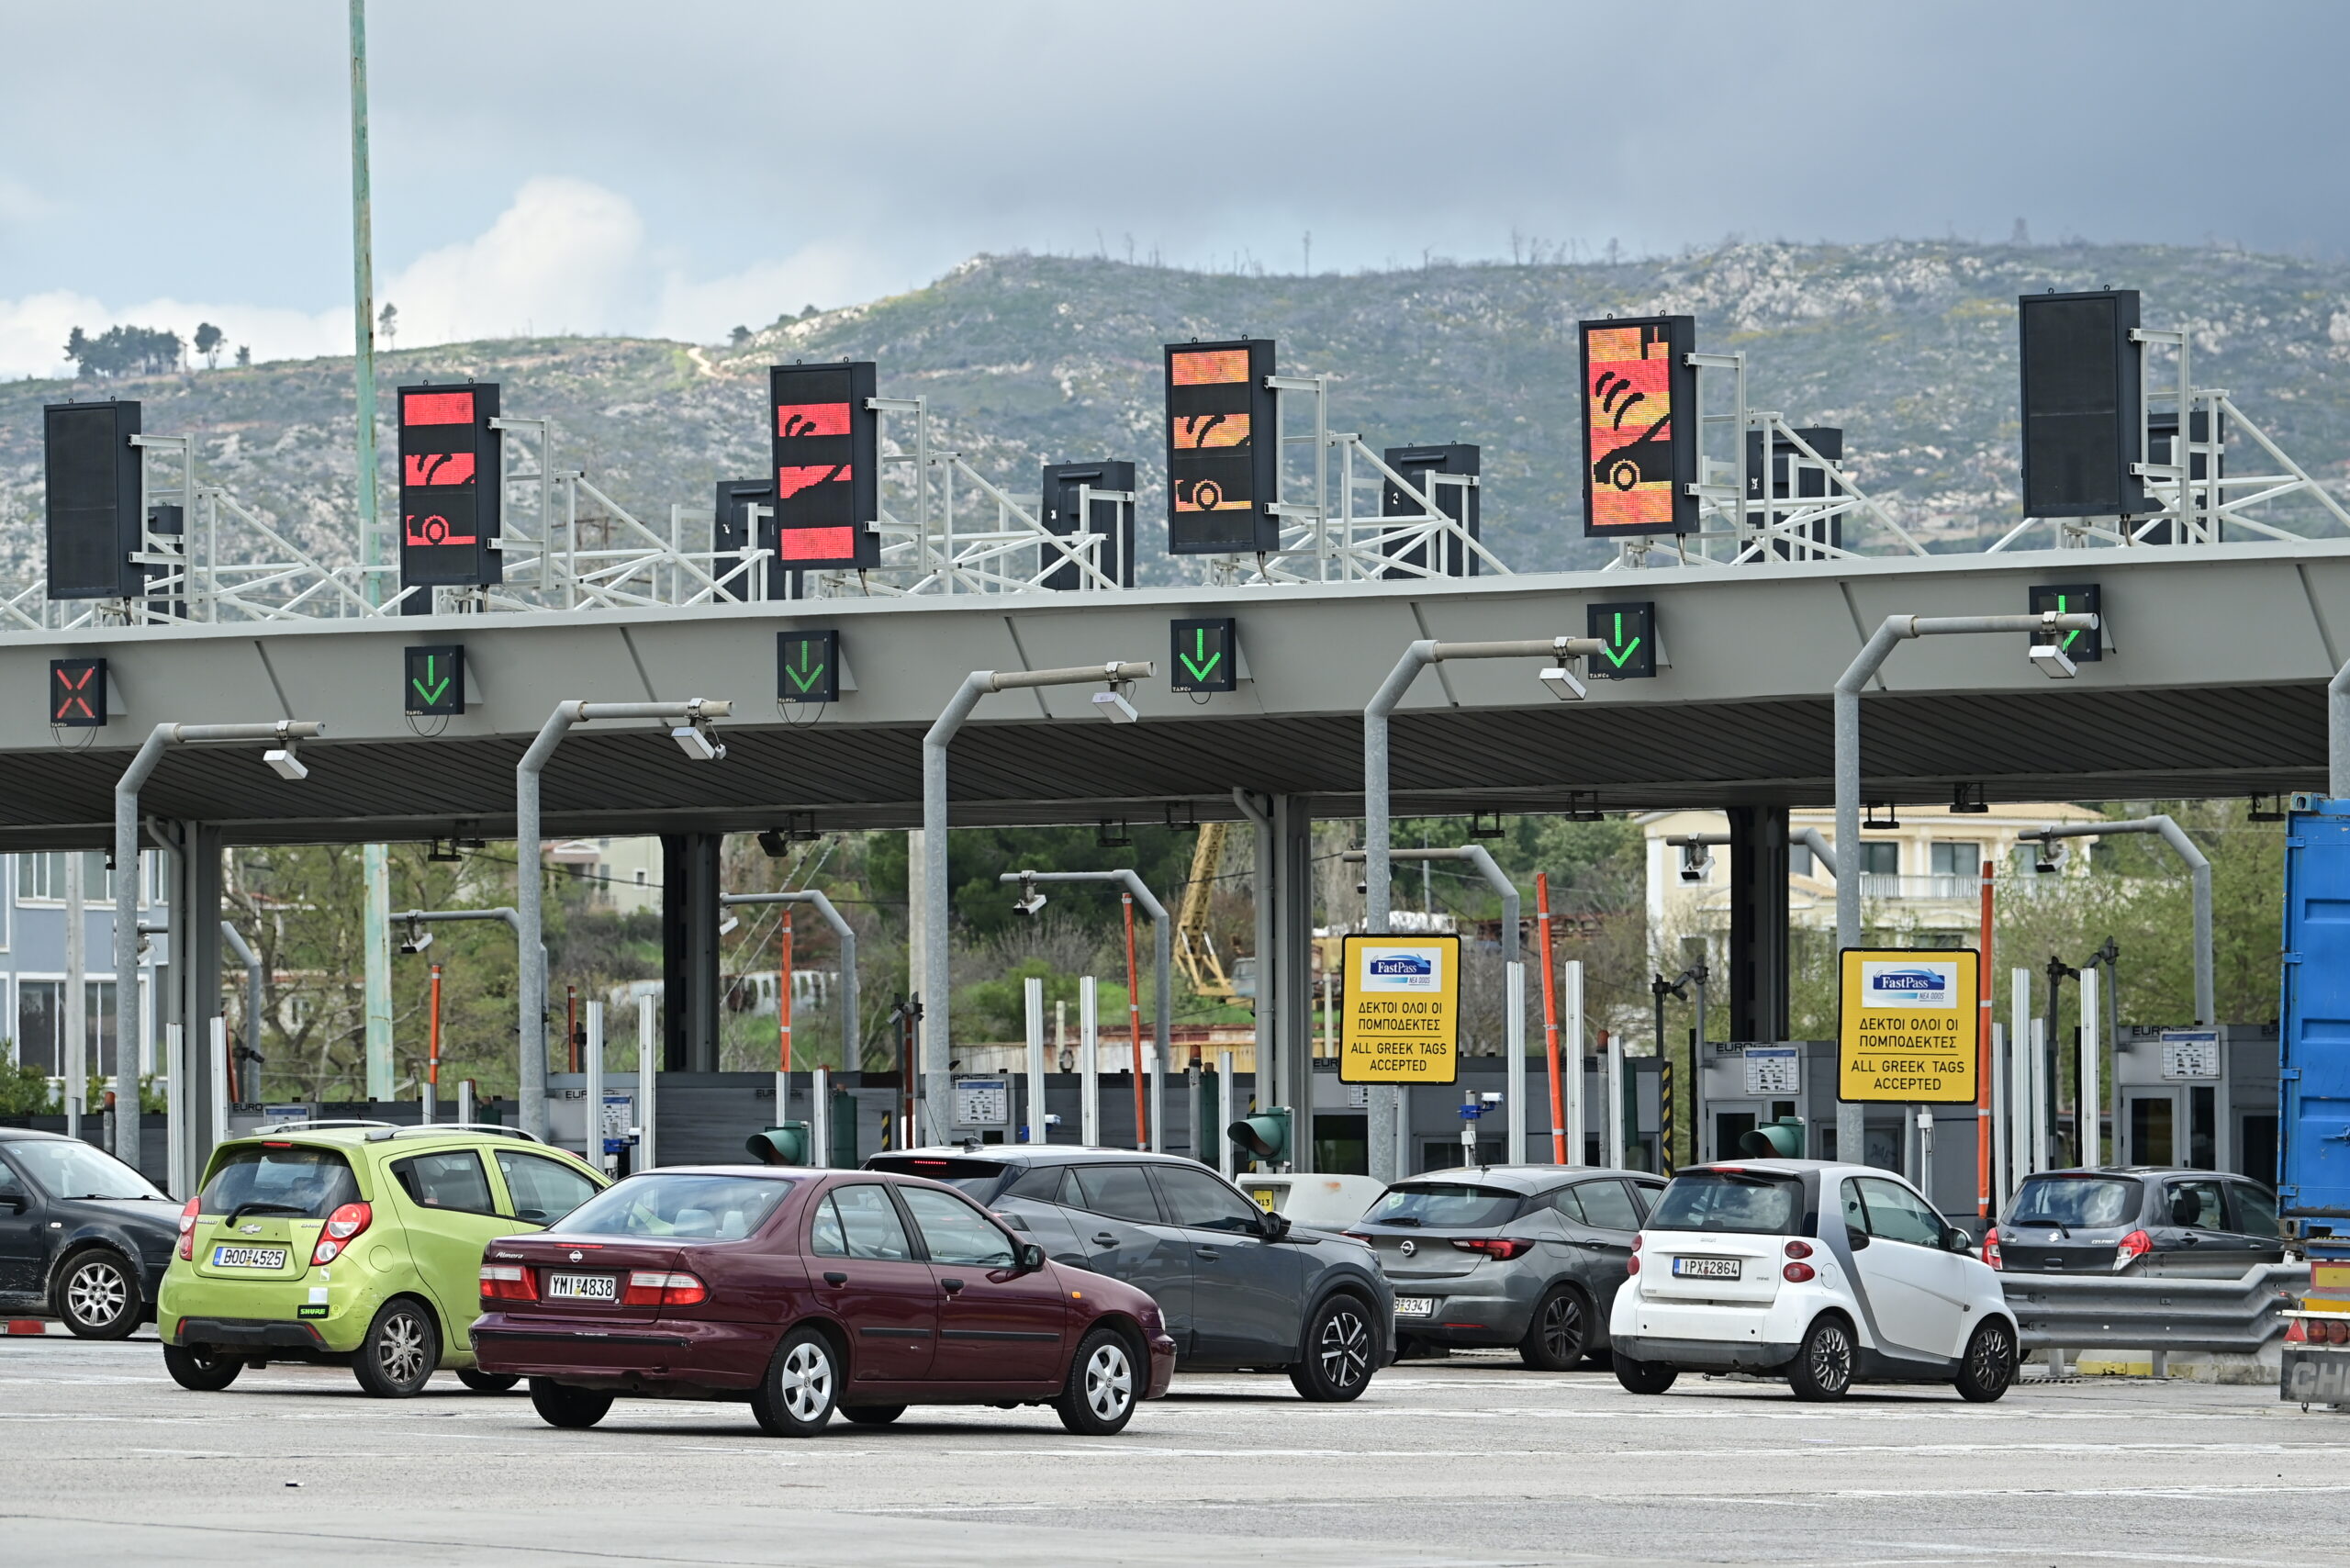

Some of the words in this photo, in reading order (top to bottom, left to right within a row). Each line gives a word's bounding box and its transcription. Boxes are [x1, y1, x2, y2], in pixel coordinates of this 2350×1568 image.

[1377, 961, 1417, 973] FastPass
[1882, 976, 1929, 989] FastPass
[1359, 1002, 1397, 1014] ΔΕΚΤΟΙ
[1402, 1002, 1427, 1014] ΟΛΟΙ
[1432, 1002, 1442, 1014] ΟΙ
[1359, 1018, 1440, 1031] ΠΟΜΠΟΔΕΚΤΕΣ
[1859, 1018, 1906, 1030] ΔΕΚΤΟΙ
[1910, 1018, 1941, 1031] ΟΛΟΙ
[1946, 1019, 1958, 1031] ΟΙ
[1350, 1042, 1371, 1054] ALL
[1377, 1043, 1414, 1055] GREEK
[1419, 1043, 1447, 1055] TAGS
[1859, 1036, 1957, 1048] ΠΟΜΠΟΔΕΚΤΕΣ
[1370, 1059, 1427, 1071] ACCEPTED
[1851, 1059, 1876, 1072] ALL
[1882, 1060, 1925, 1072] GREEK
[1932, 1060, 1964, 1073] TAGS
[1874, 1078, 1942, 1091] ACCEPTED
[2289, 1361, 2350, 1397] CH
